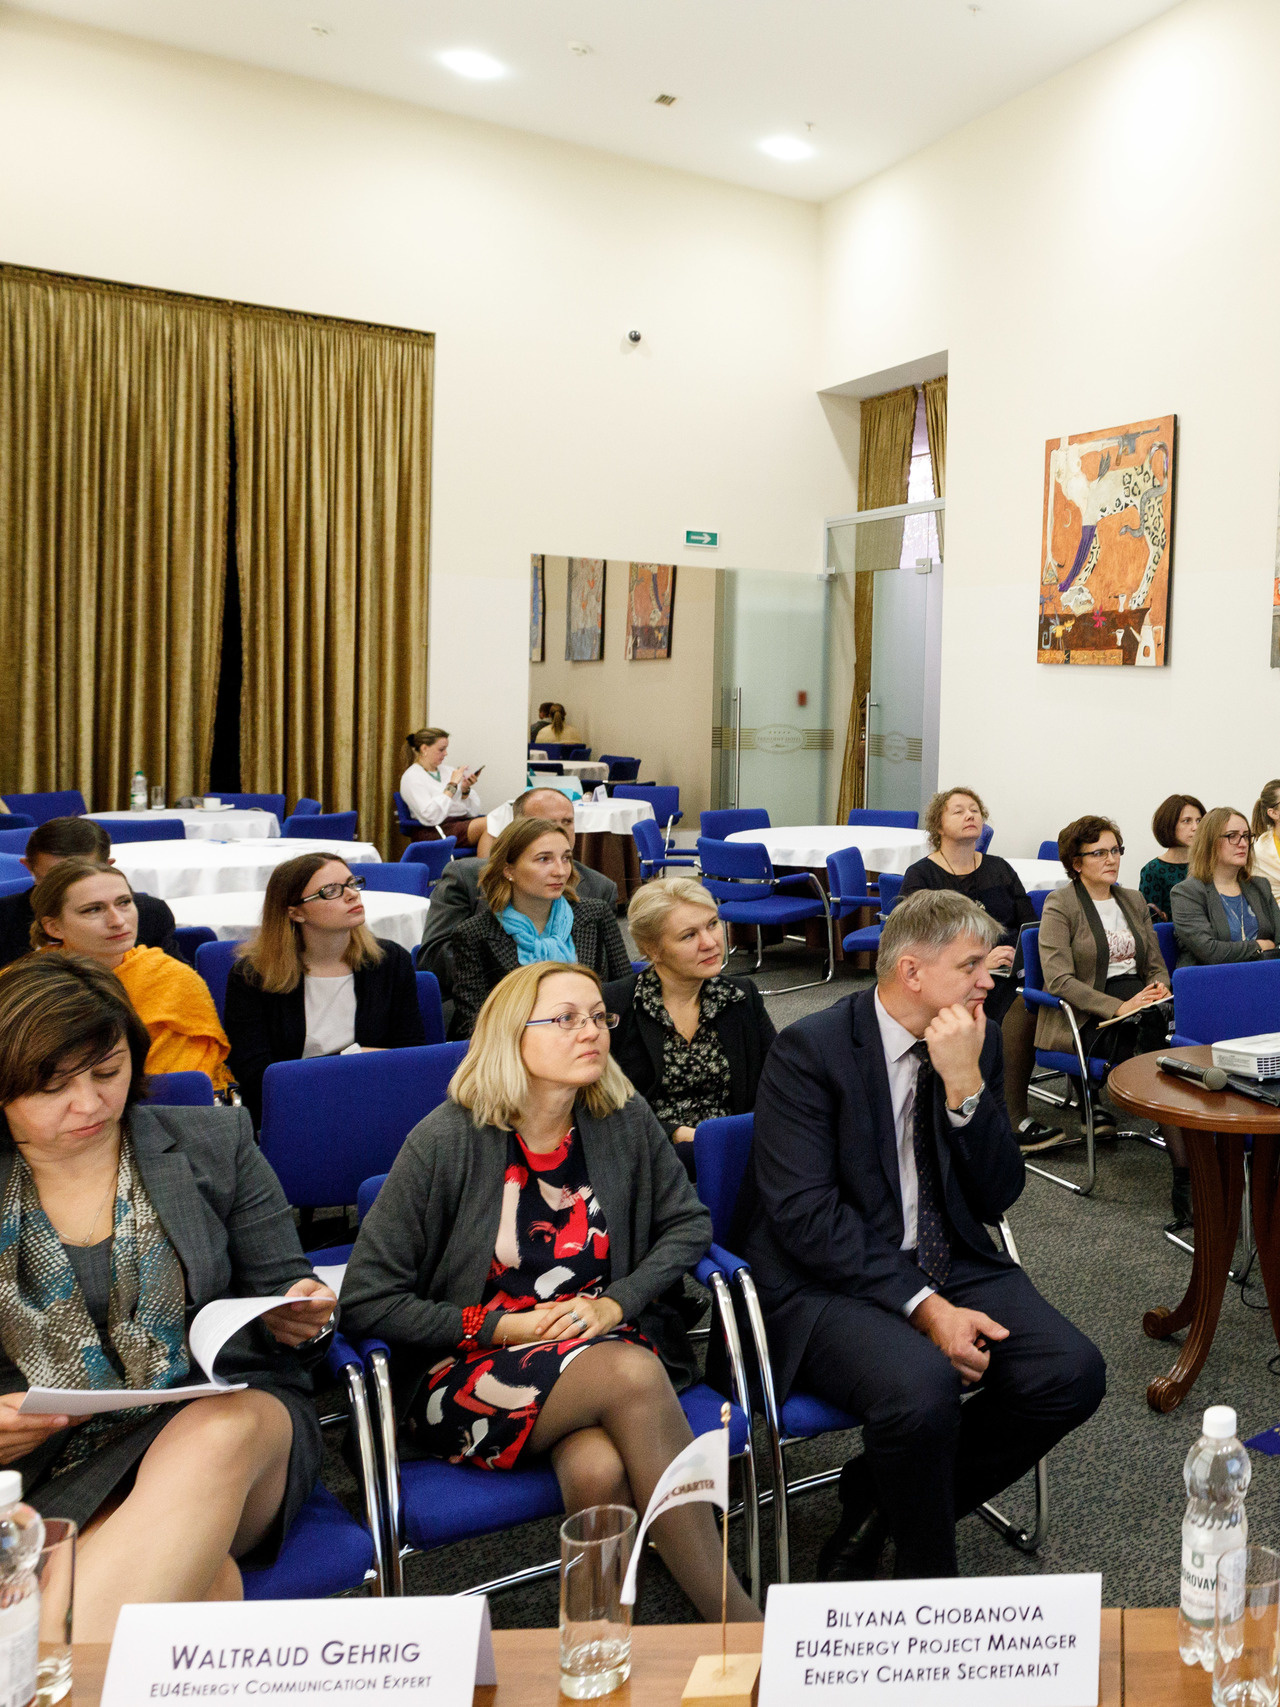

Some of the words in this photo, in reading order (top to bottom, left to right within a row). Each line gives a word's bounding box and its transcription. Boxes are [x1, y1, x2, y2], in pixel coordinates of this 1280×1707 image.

[671, 1479, 715, 1497] CHARTER
[825, 1608, 907, 1629] BILYANA
[915, 1604, 1045, 1627] CHOBANOVA
[171, 1643, 310, 1671] WALTRAUD
[319, 1639, 422, 1666] GEHRIG
[794, 1639, 901, 1659] EU4ENERGY
[906, 1635, 982, 1655] PROJECT
[987, 1633, 1078, 1652] MANAGER
[149, 1681, 240, 1699] EU4ENERGY
[244, 1677, 378, 1696] COMMUNICATION
[382, 1673, 433, 1691] EXPERT
[803, 1667, 870, 1686] ENERGY
[875, 1665, 951, 1684] CHARTER
[956, 1661, 1060, 1681] SECRETARIAT
